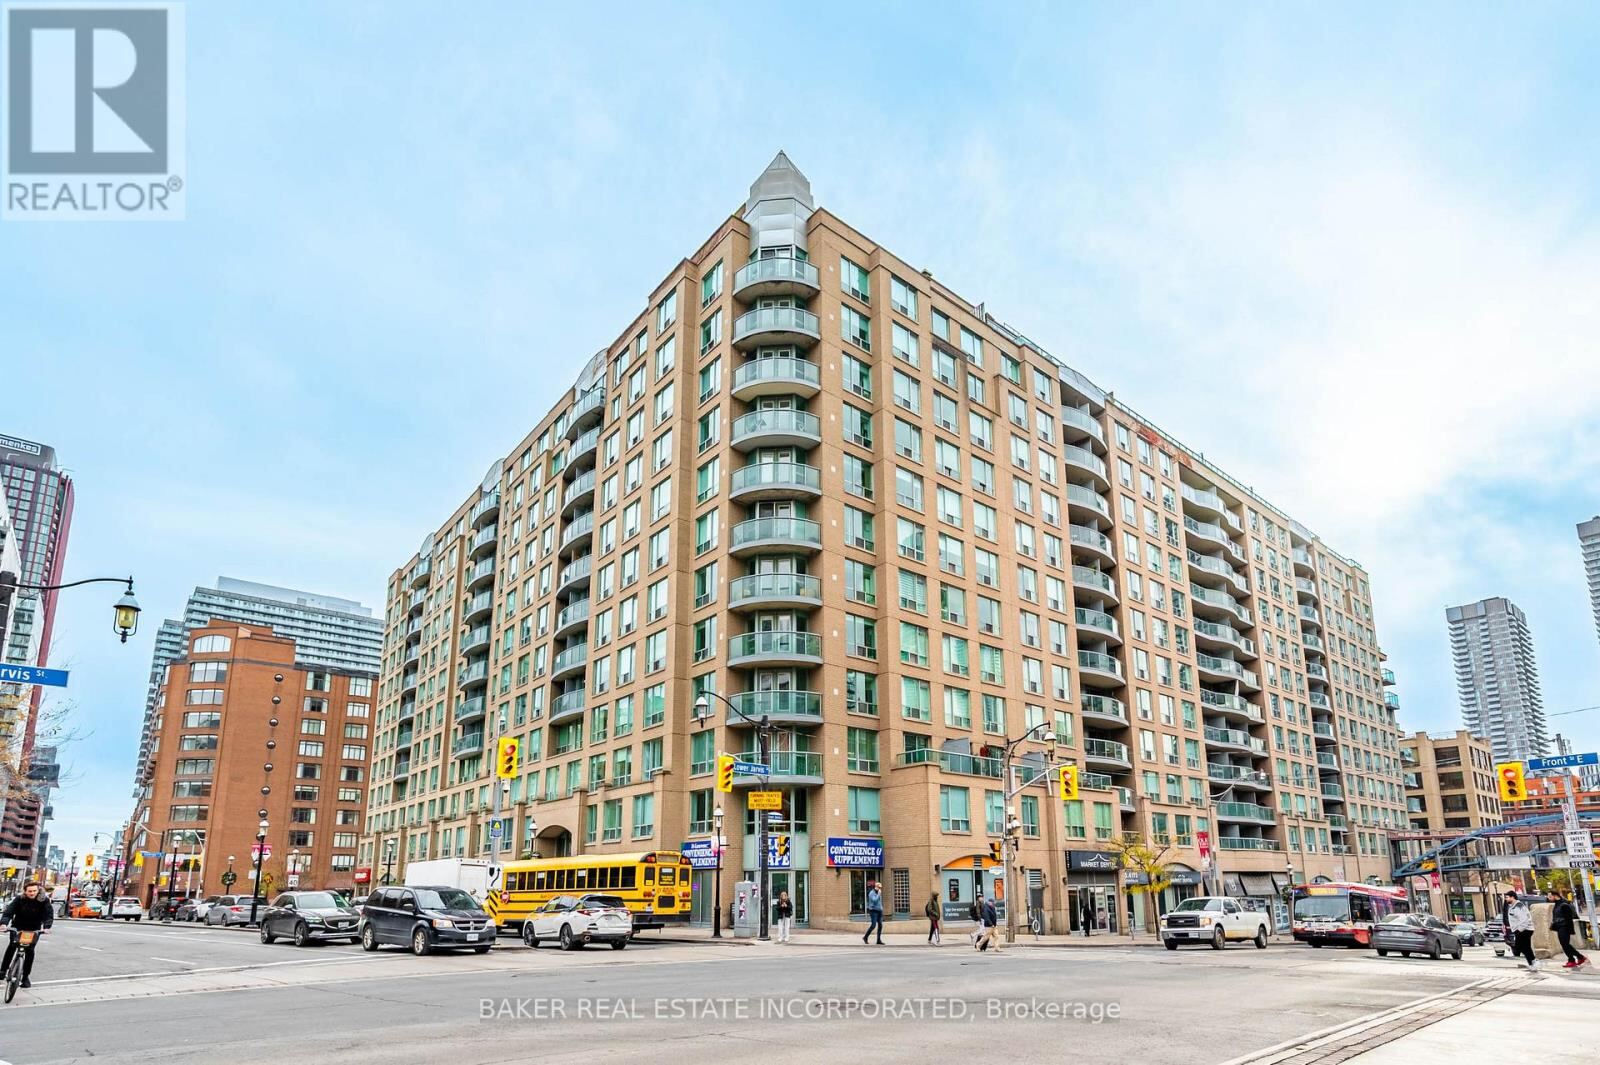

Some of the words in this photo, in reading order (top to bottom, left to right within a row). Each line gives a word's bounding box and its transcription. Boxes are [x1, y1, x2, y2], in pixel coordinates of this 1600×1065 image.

[0, 668, 31, 680] rvis
[1541, 757, 1567, 767] Front
[1577, 755, 1584, 763] E
[682, 848, 714, 858] CONVENIENC
[830, 846, 876, 855] CONVENIENCE
[834, 855, 880, 865] SUPPLEMENTS
